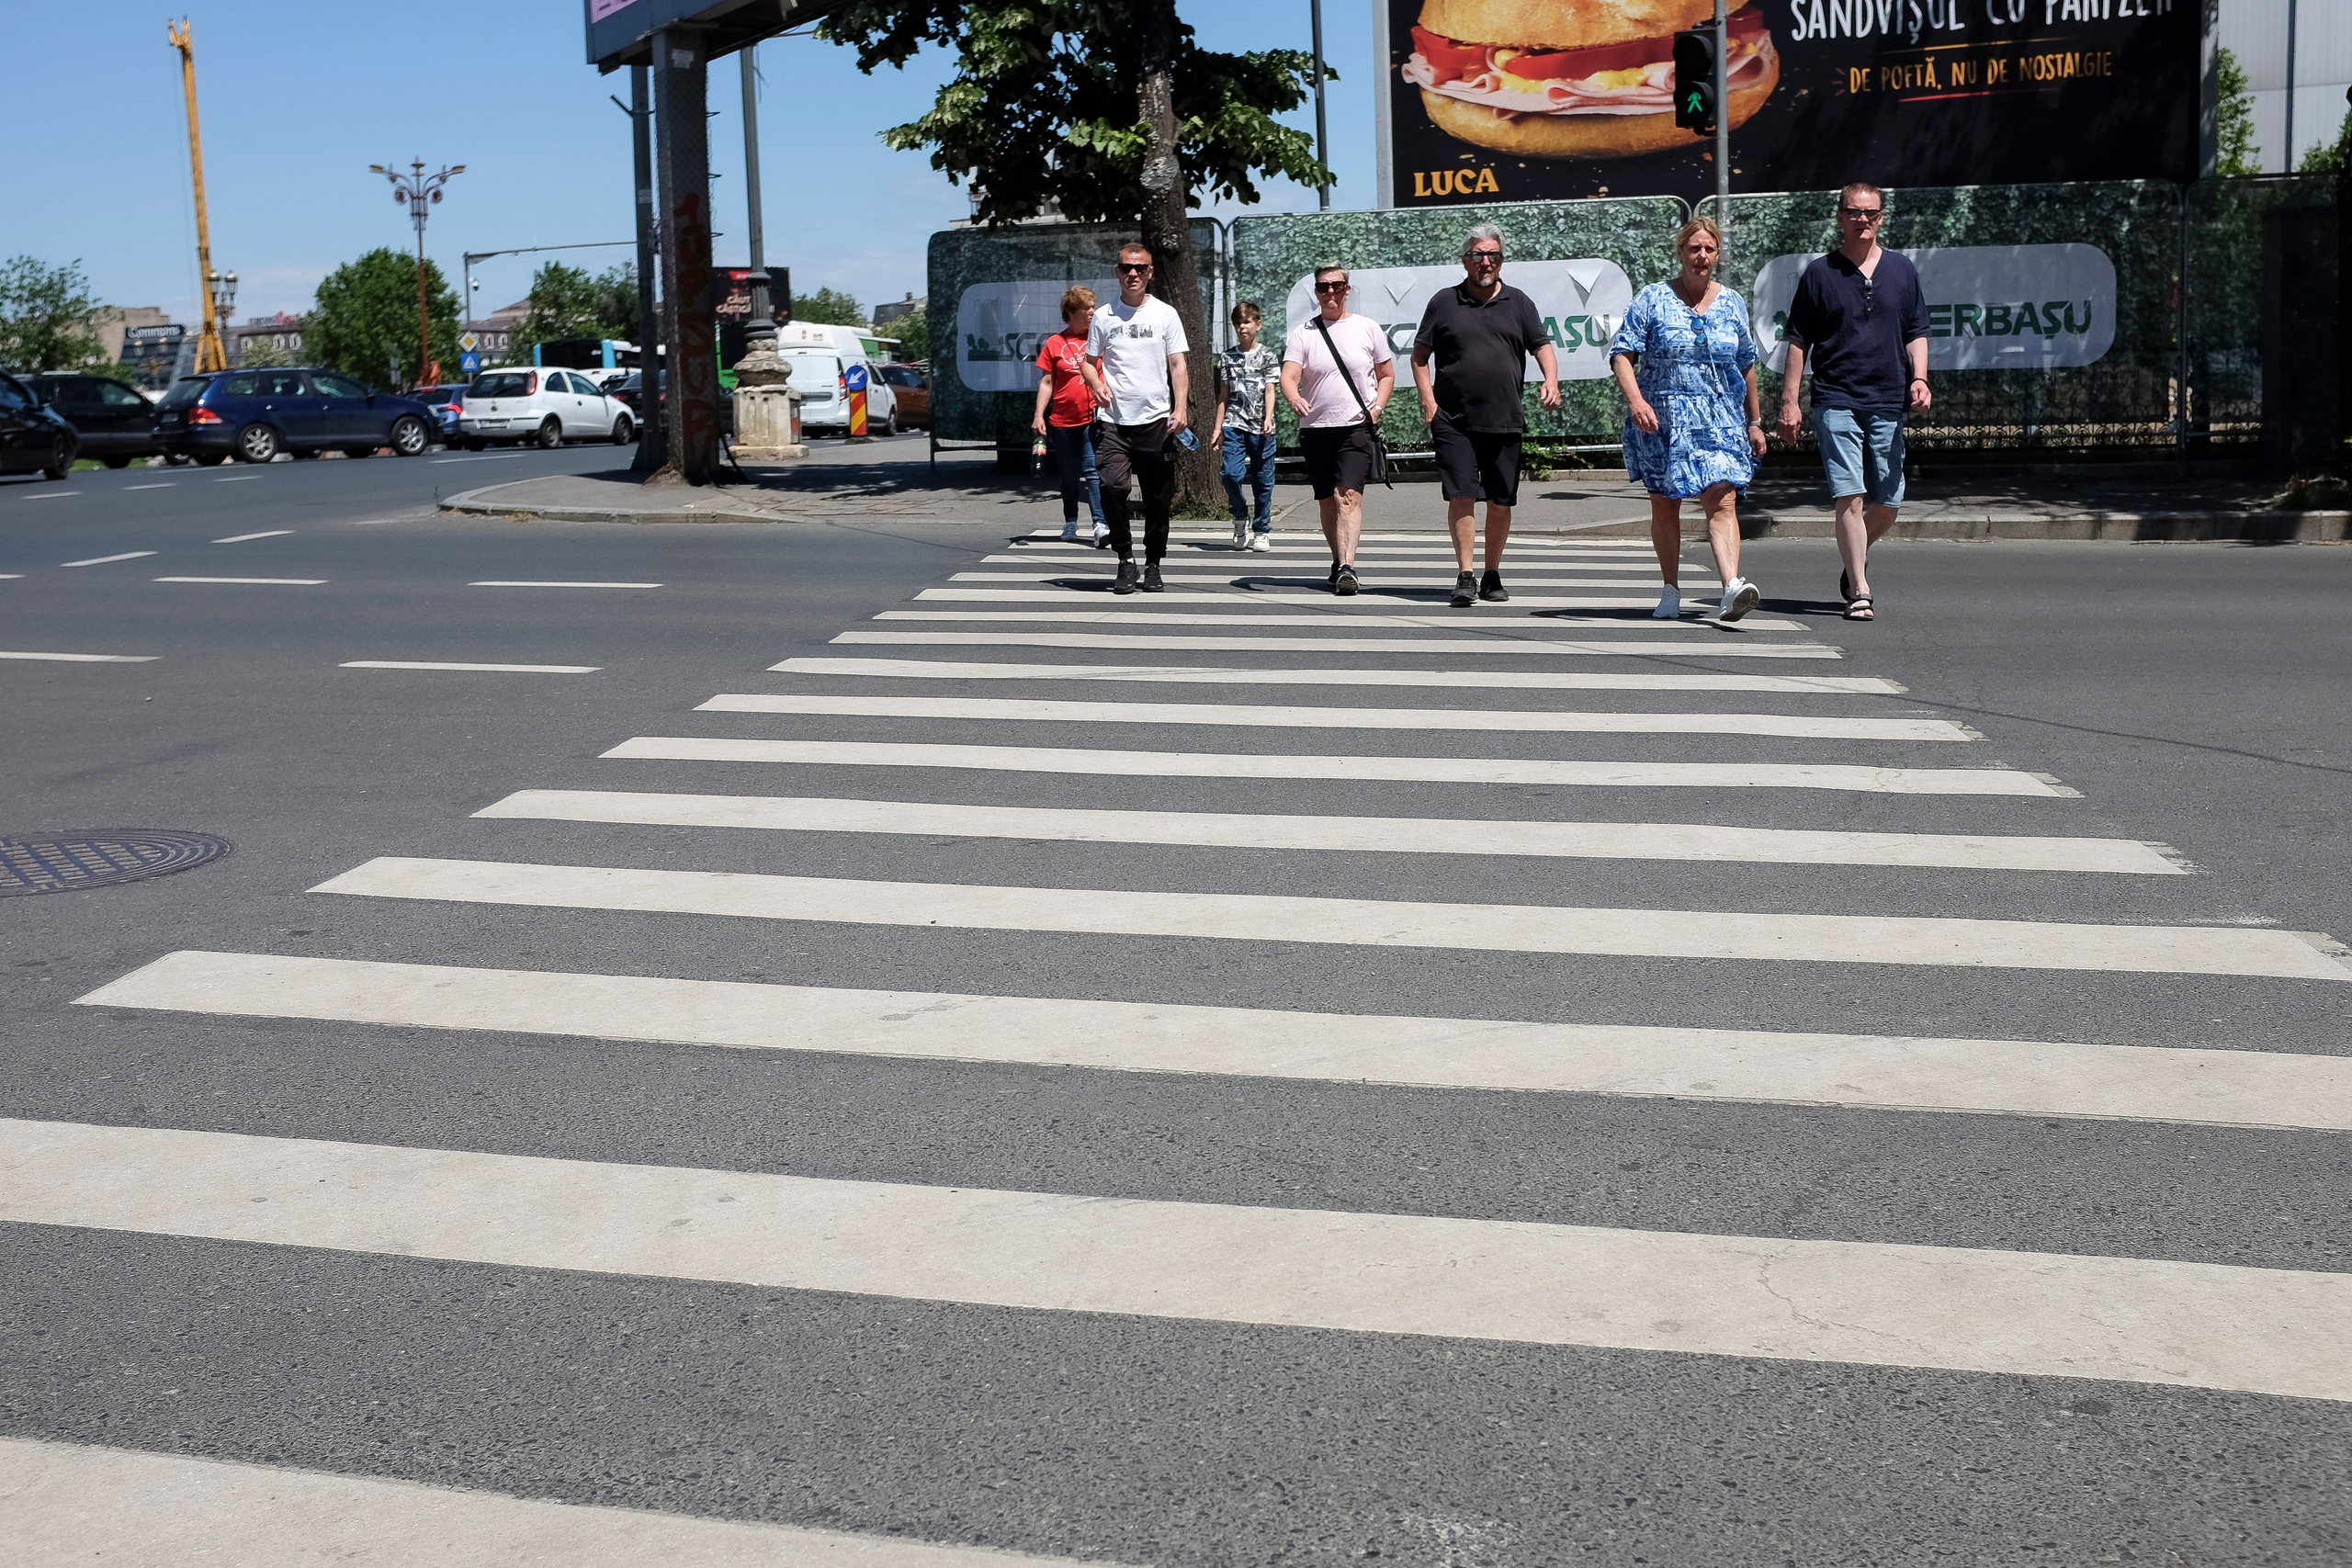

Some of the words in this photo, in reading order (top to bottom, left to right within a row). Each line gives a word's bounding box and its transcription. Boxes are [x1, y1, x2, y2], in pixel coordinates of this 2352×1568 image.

[1849, 66, 1871, 94] DE
[1951, 60, 1977, 87] NU
[1986, 57, 2009, 85] DE
[2019, 51, 2113, 82] NOSTALGIE
[1413, 167, 1499, 197] LUCA
